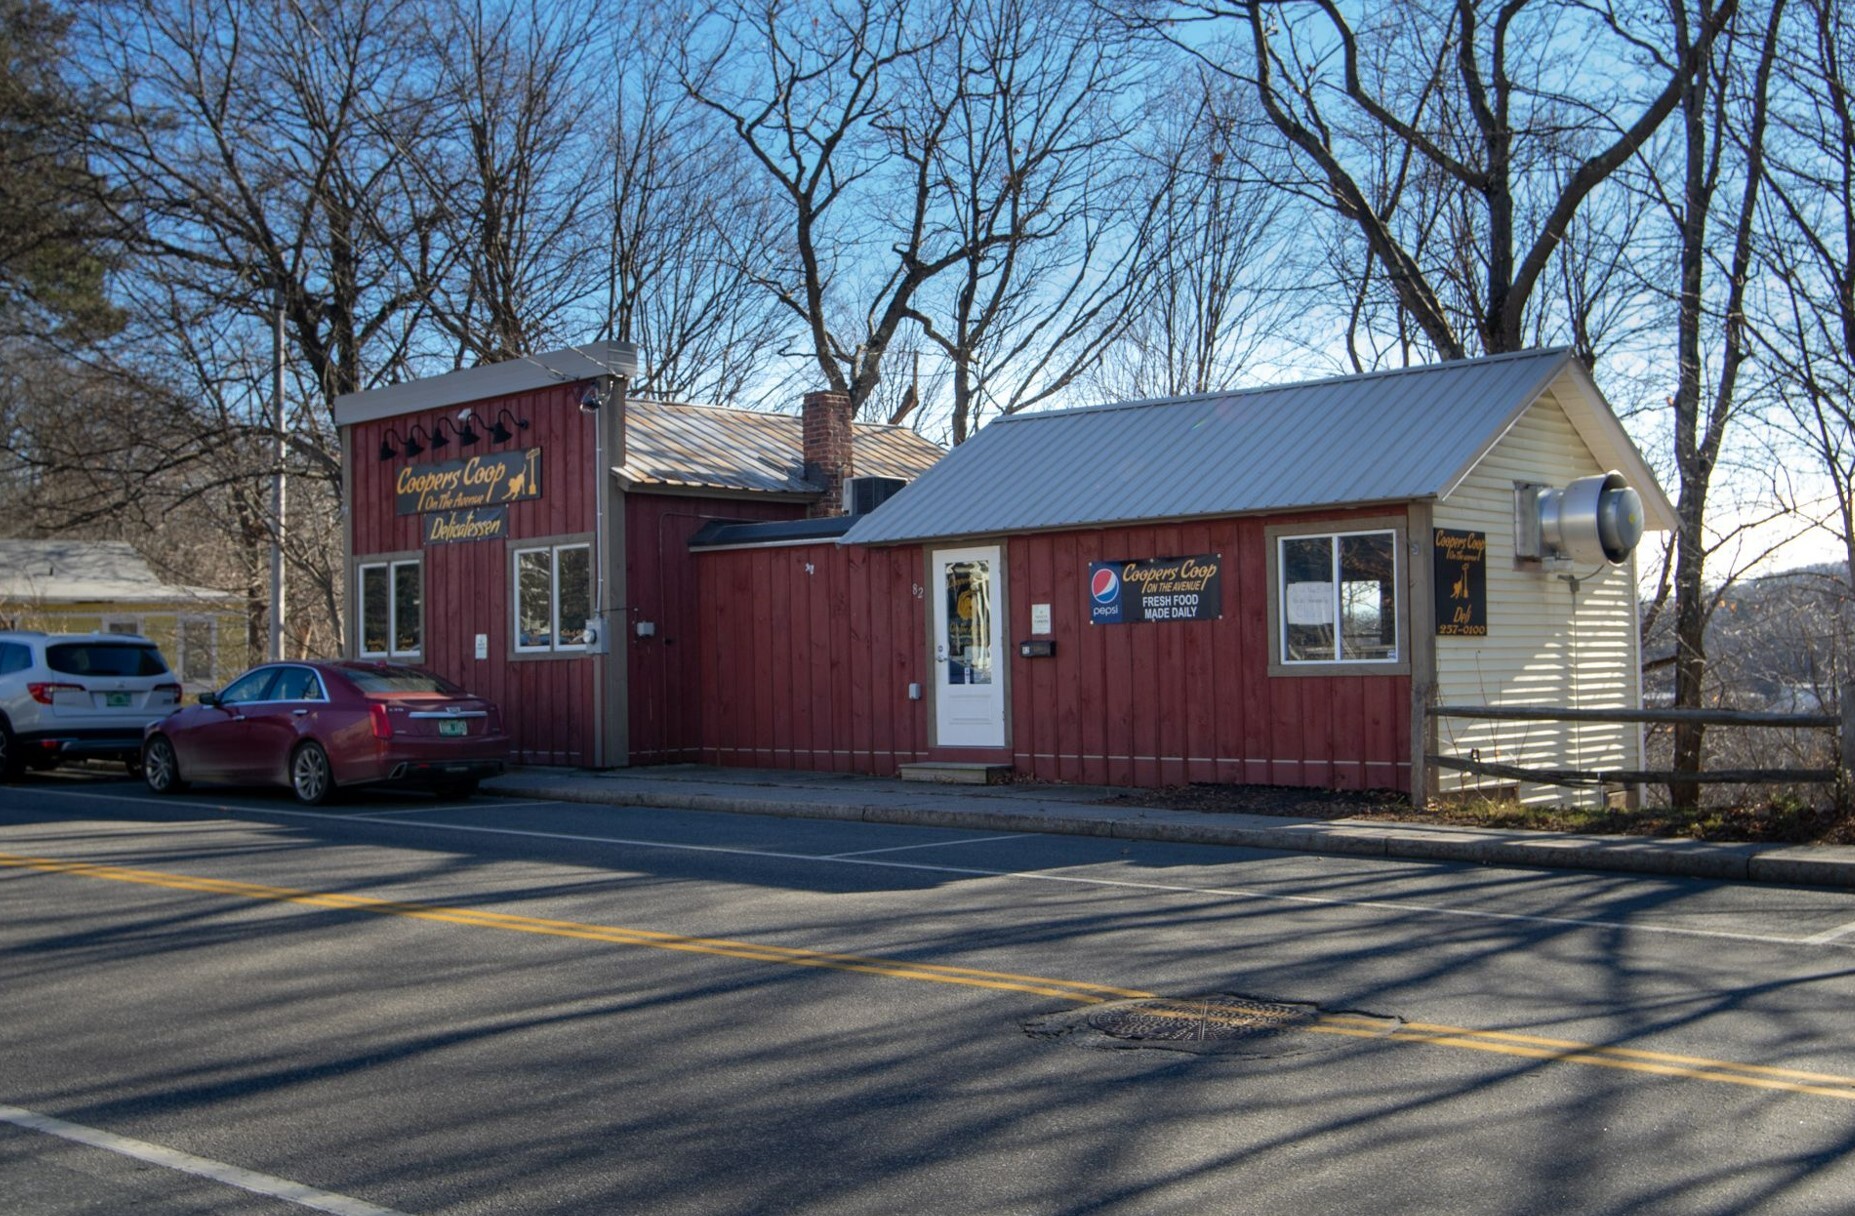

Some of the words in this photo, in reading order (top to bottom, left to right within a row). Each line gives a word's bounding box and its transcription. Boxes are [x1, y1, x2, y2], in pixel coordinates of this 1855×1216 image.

[396, 466, 462, 511] Coopers
[463, 456, 506, 503] Coop
[425, 495, 438, 510] On
[430, 511, 501, 540] Delicatessen
[1435, 529, 1466, 559] Coopers
[1467, 532, 1485, 561] Coop
[1122, 563, 1177, 593] Coopers
[1180, 559, 1217, 590] Coop
[912, 583, 924, 598] 82
[1147, 582, 1158, 593] ON
[1159, 582, 1171, 592] THE
[1172, 580, 1201, 591] AVENUE
[1142, 596, 1171, 607] FRESH
[1173, 594, 1199, 606] FOOD
[1093, 605, 1118, 616] pepsi
[1144, 608, 1170, 619] MADE
[1171, 606, 1197, 618] DAILY
[1453, 604, 1472, 624] Deli
[1439, 624, 1485, 635] 257-0100
